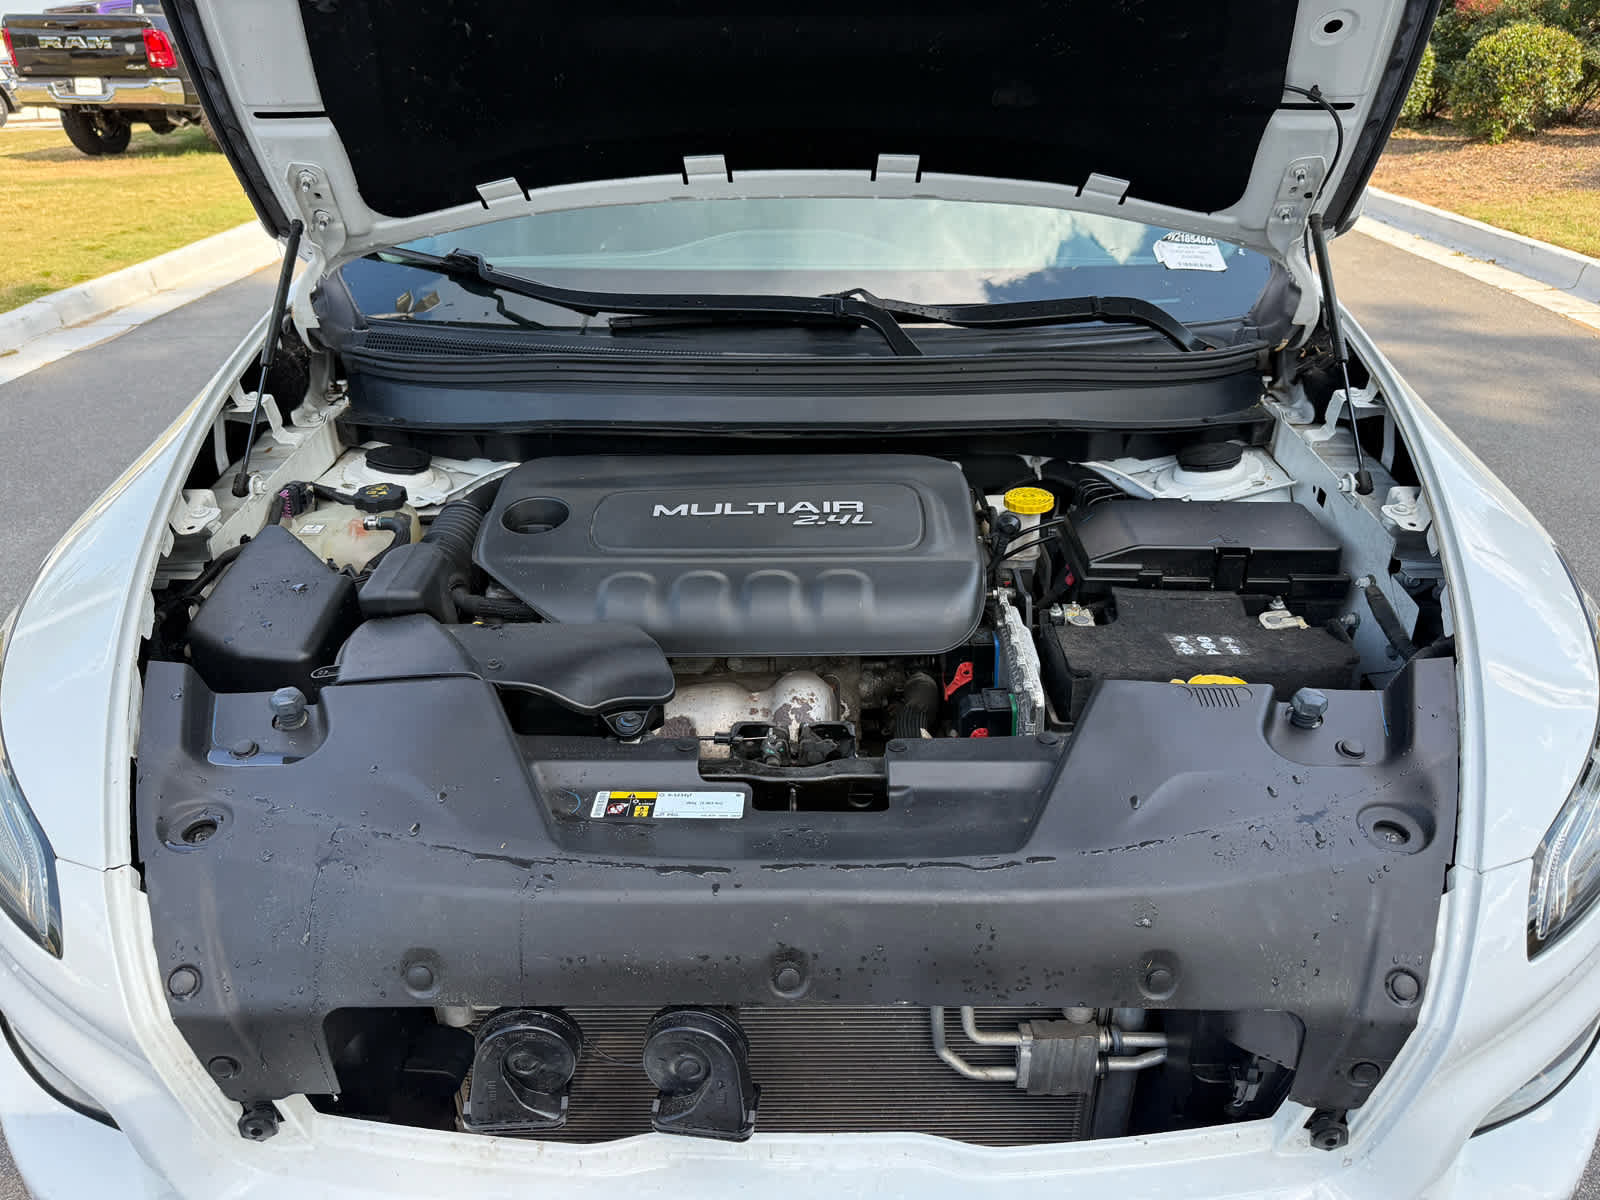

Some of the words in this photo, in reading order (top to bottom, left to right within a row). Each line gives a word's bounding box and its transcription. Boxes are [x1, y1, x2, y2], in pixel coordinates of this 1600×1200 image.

[38, 36, 112, 49] RAM
[652, 501, 864, 517] MULTIAIR
[792, 514, 873, 526] 2.4L
